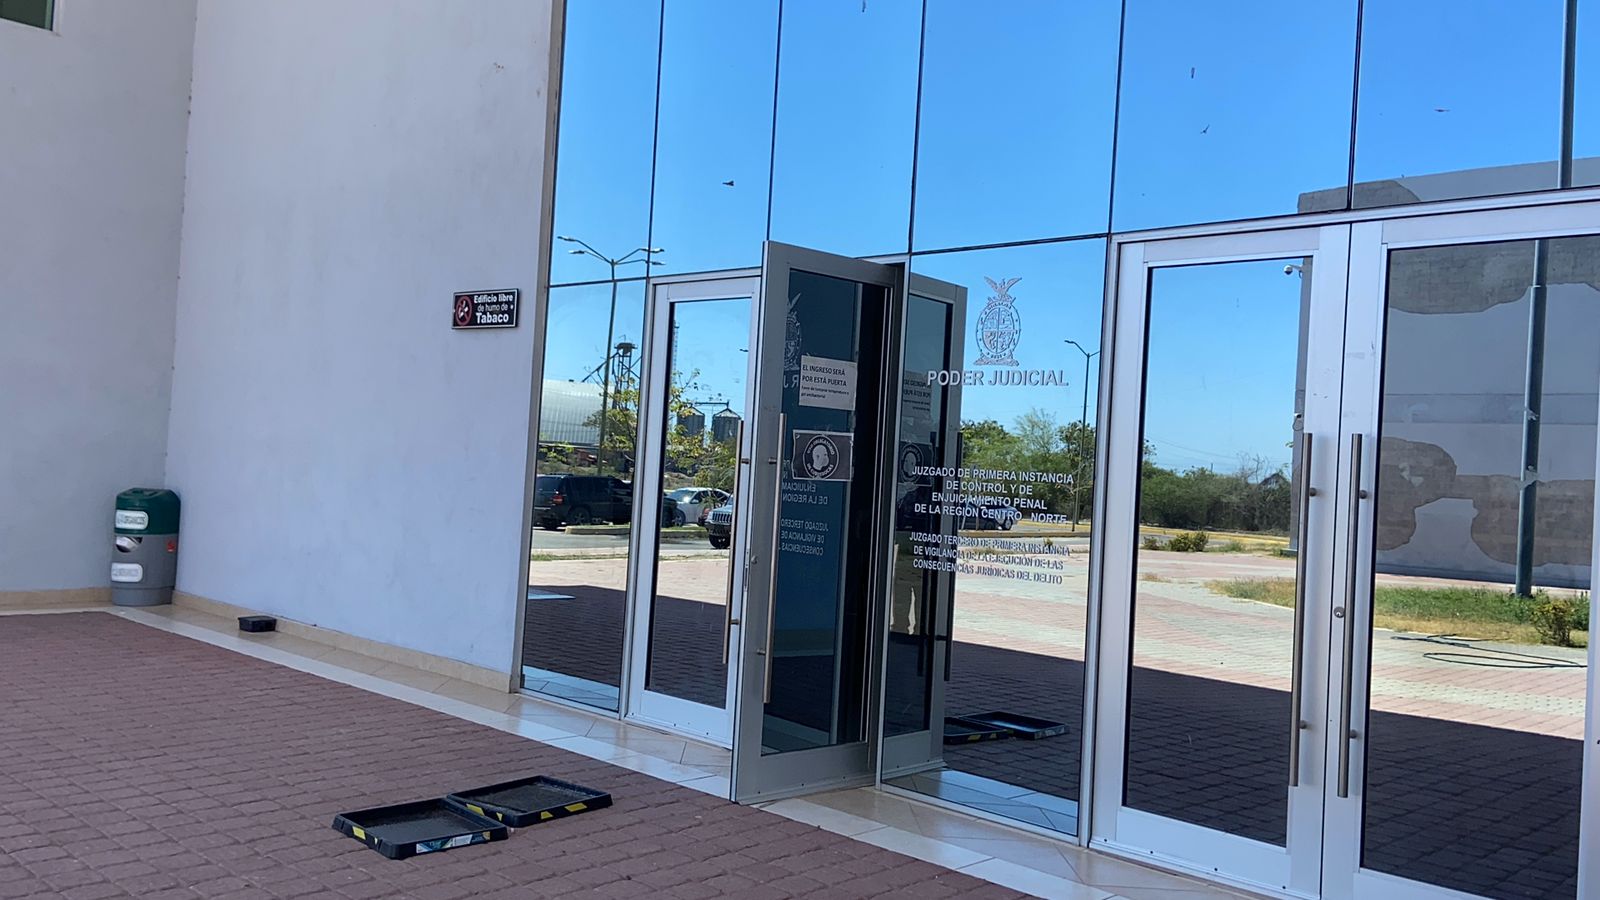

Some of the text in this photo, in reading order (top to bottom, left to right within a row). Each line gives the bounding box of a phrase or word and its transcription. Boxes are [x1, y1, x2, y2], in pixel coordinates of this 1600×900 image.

[474, 294, 513, 303] Edificio libre
[477, 304, 484, 312] de
[476, 312, 509, 324] Tabaco
[810, 366, 832, 374] INGRESO
[833, 368, 846, 376] SERÁ
[927, 370, 985, 386] PODER
[988, 370, 1069, 386] JUDICIAL
[912, 466, 1074, 484] JUZGADO DE PRIMERA INSTANCIA
[946, 480, 1033, 495] DE CONTROL Y DE
[932, 492, 1048, 510] ENJUICIAMIENTO PENAL
[914, 504, 927, 513] DE
[929, 505, 941, 514] LA
[981, 509, 1022, 521] CENTRO
[1030, 512, 1067, 524] NORTE
[909, 532, 1070, 556] JUZGADO TERCERO DE PRIMERA INSTANCIA
[914, 545, 923, 555] DE
[925, 546, 965, 560] VIGILANCIA
[967, 550, 977, 560] DE
[978, 551, 991, 562] LA
[1034, 557, 1046, 567] DE
[1048, 559, 1064, 570] LAS
[1016, 571, 1032, 581] DEL
[1033, 572, 1063, 584] DELITO
